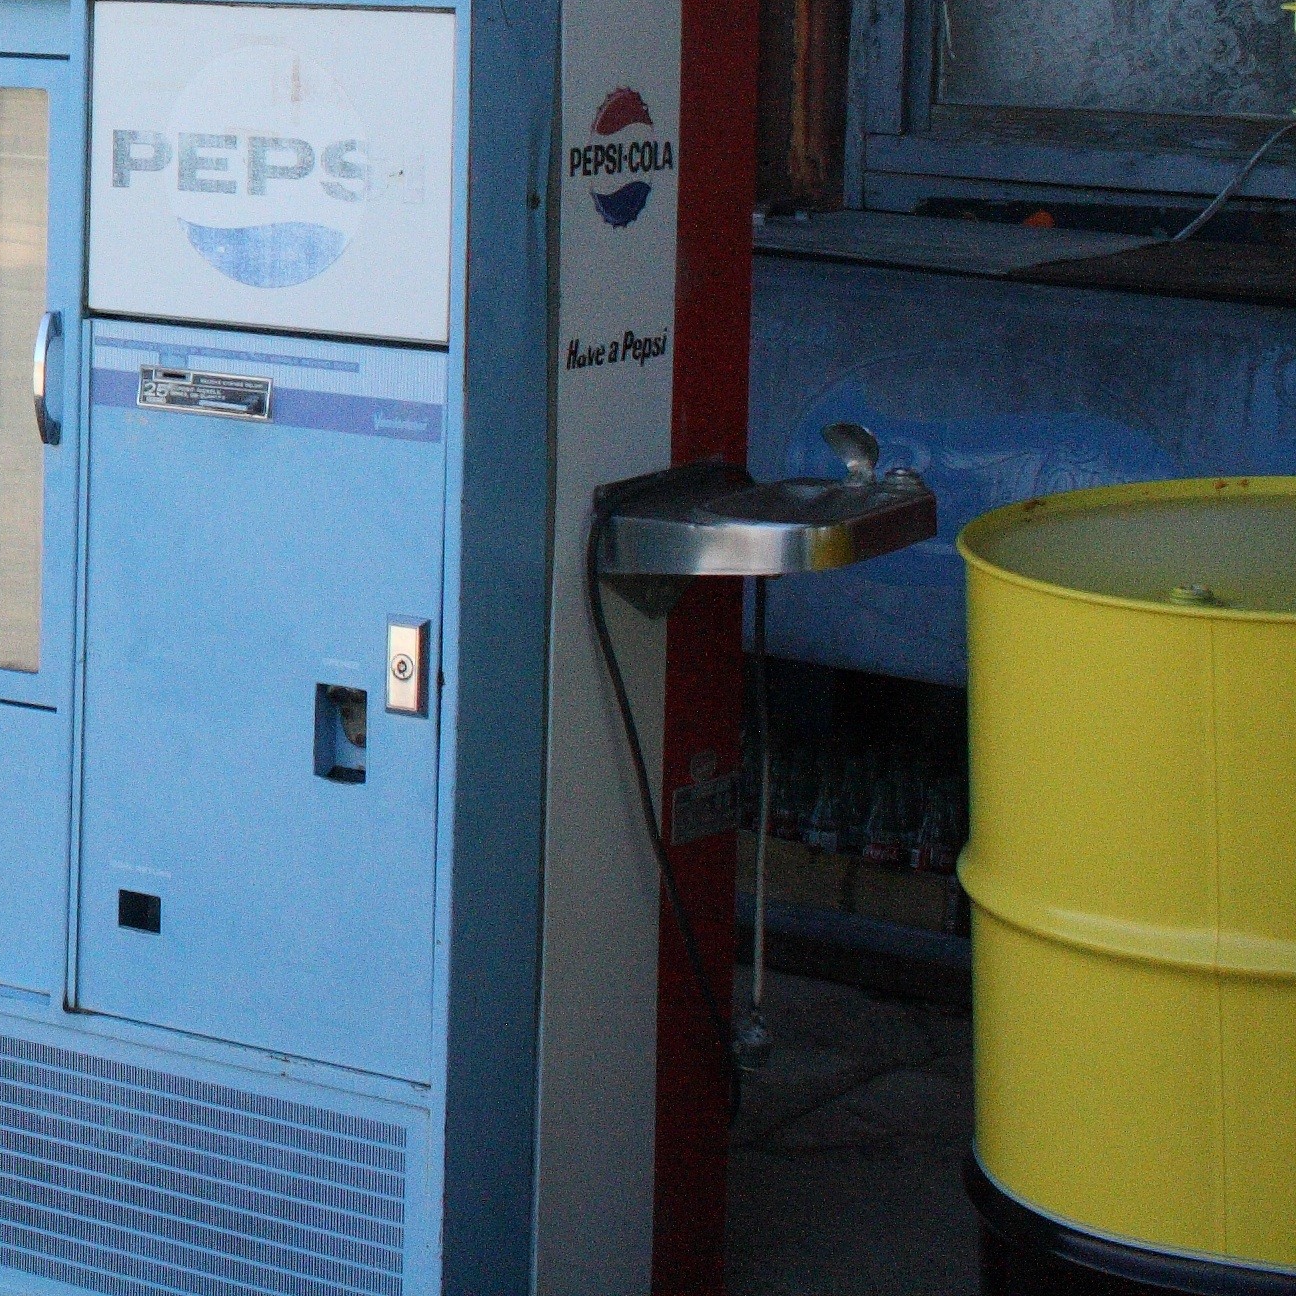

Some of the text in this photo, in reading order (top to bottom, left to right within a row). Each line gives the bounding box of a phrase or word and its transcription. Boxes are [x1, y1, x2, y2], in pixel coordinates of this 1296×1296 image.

[566, 328, 668, 371] Have a Pepsi
